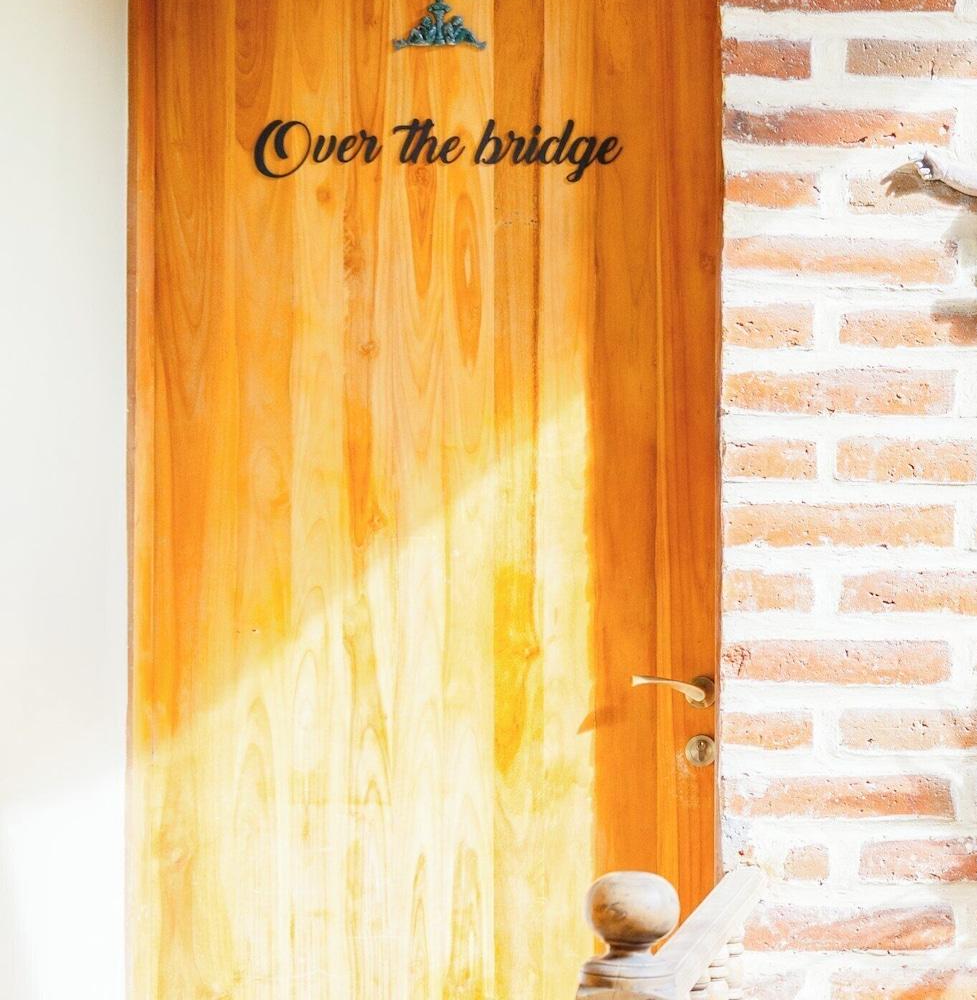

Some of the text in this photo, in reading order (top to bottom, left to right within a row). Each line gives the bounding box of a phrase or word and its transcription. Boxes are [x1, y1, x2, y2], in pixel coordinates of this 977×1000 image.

[253, 118, 624, 183] Over the bridge
